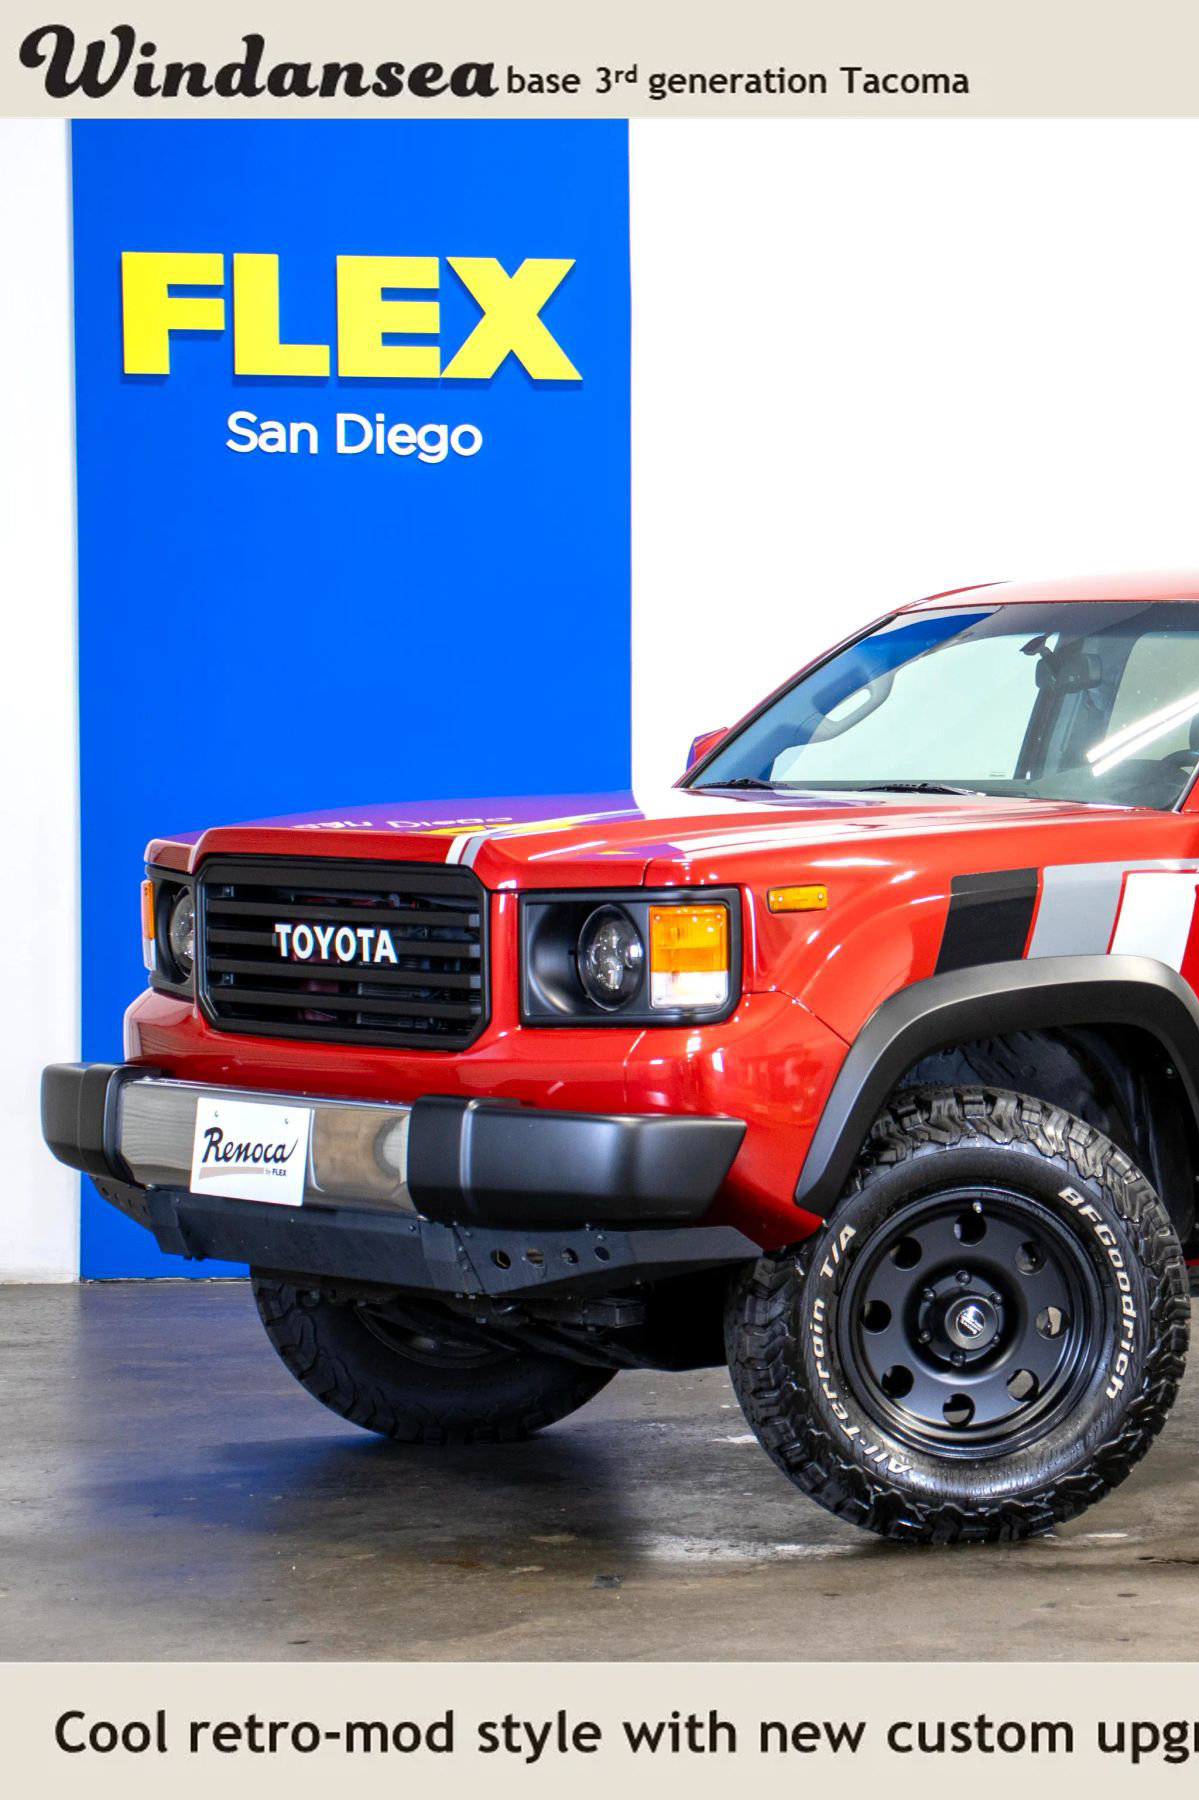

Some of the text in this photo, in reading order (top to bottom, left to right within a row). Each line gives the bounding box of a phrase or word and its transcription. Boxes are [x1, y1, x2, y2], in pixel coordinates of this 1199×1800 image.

[121, 251, 584, 381] FLEX
[225, 410, 483, 464] San Diego
[275, 923, 399, 964] TOYOTA
[201, 1126, 299, 1163] Renoca
[272, 1168, 287, 1177] FLEX
[1057, 1186, 1137, 1399] BFGoodrich
